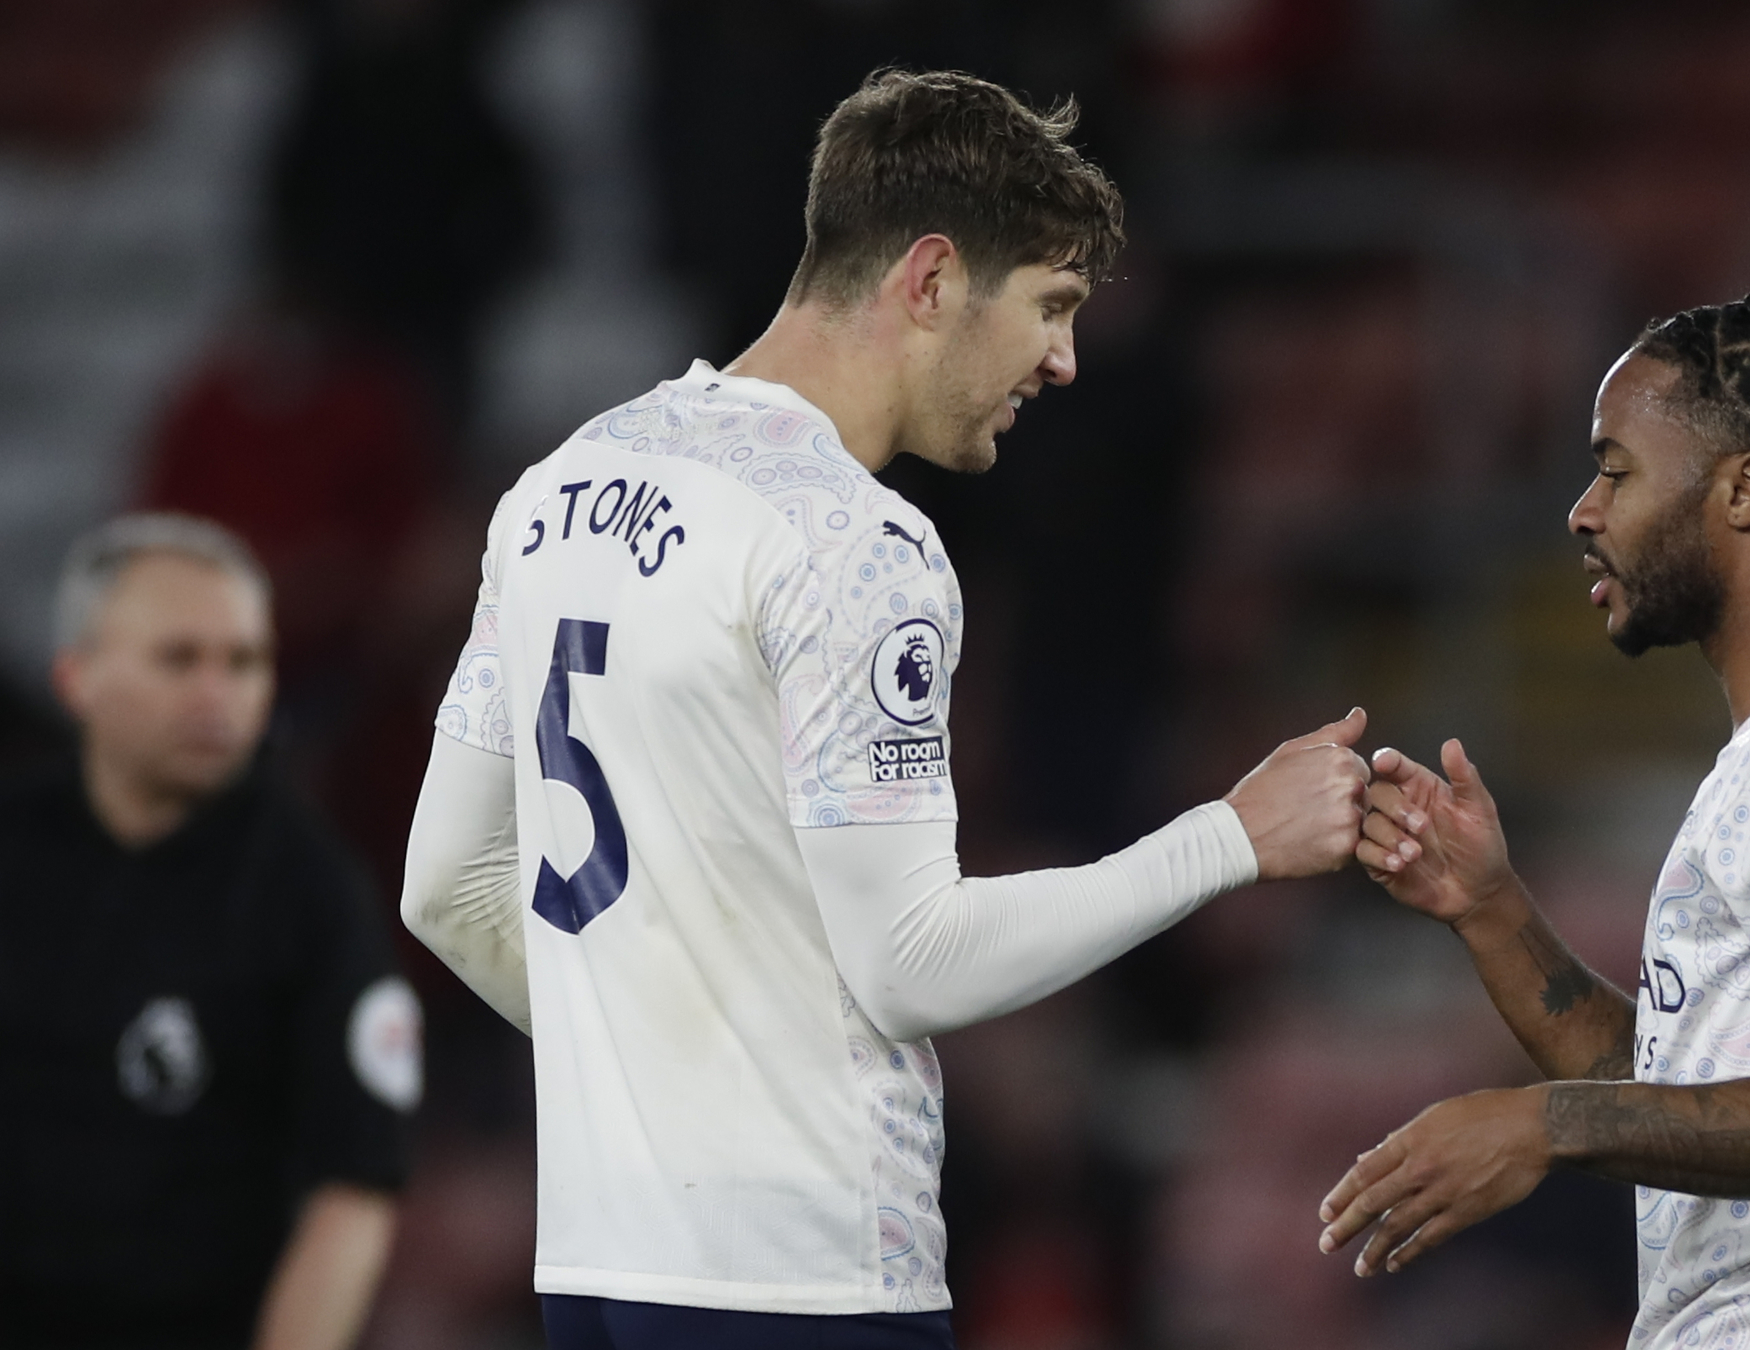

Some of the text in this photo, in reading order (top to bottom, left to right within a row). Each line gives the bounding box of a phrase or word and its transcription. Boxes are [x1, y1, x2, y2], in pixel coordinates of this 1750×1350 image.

[522, 478, 685, 578] STONES
[532, 617, 629, 936] 5
[869, 741, 941, 761] No room
[901, 761, 946, 778] racism
